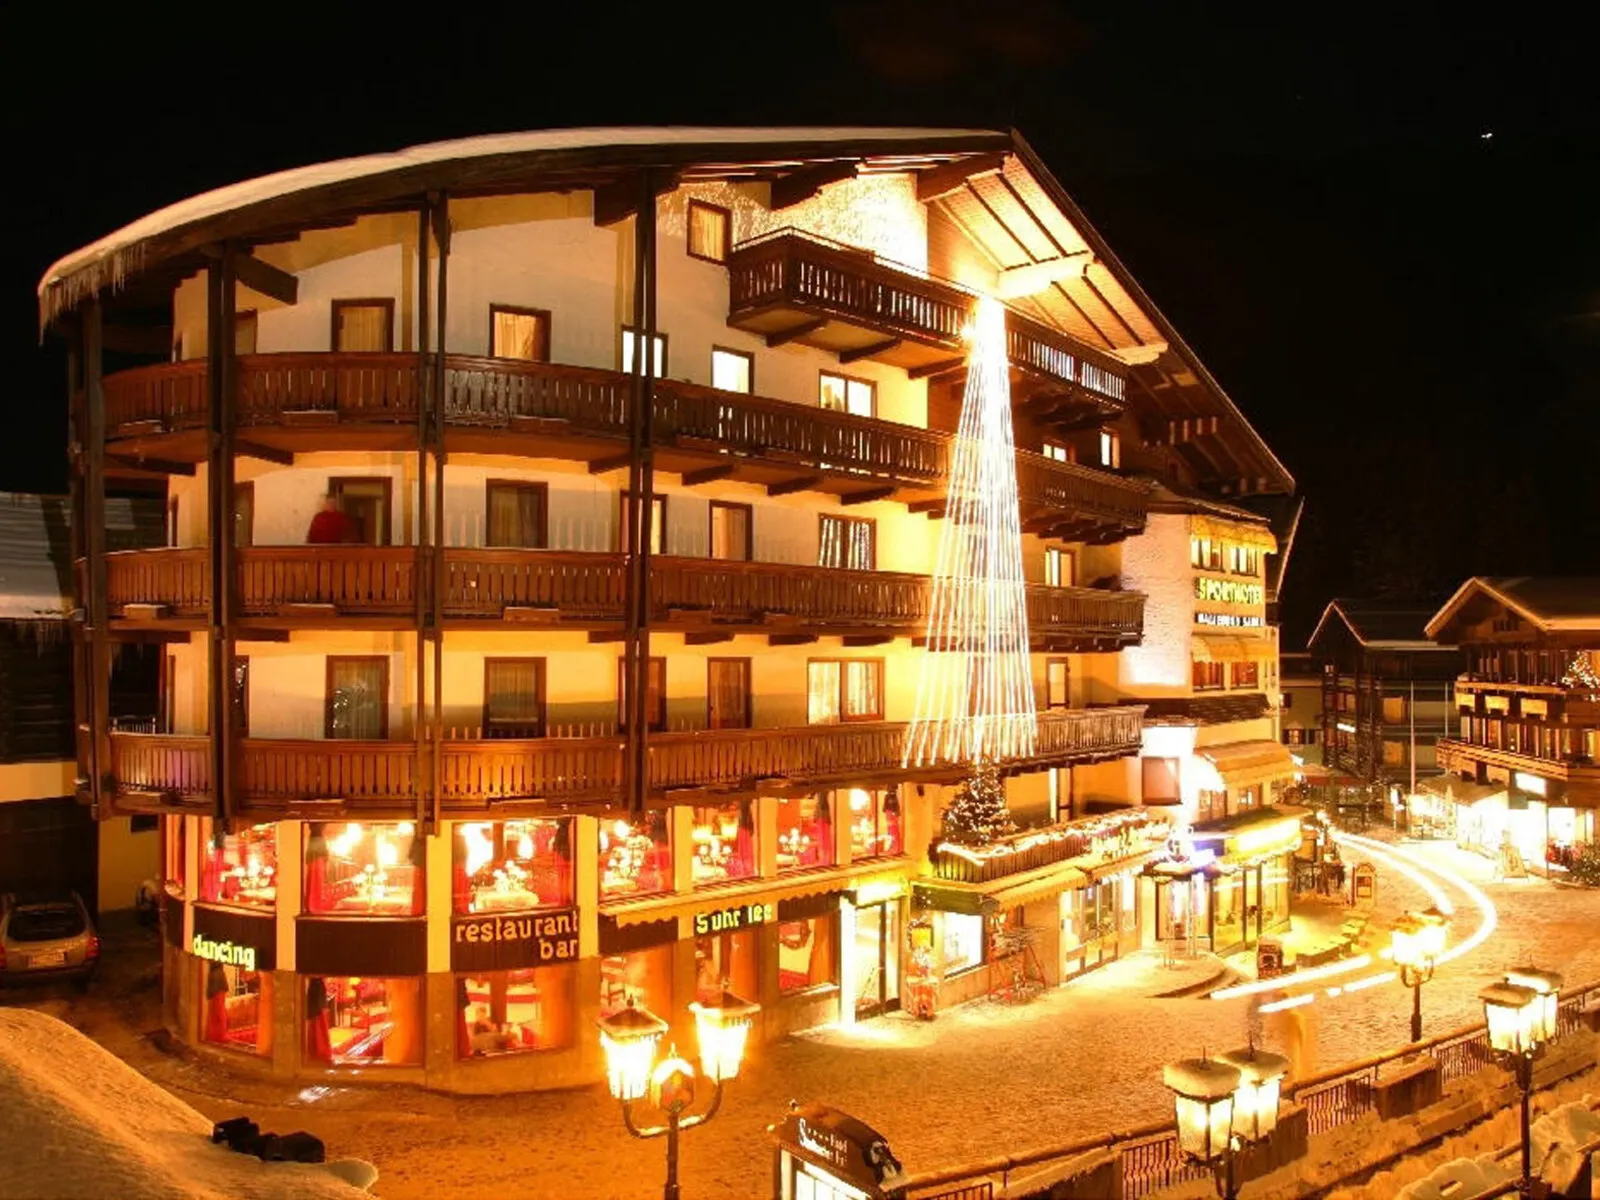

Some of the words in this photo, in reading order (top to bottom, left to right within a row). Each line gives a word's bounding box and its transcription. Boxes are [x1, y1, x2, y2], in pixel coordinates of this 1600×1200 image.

[456, 910, 578, 942] restaurant
[193, 934, 255, 971] dancing
[539, 939, 577, 959] bar
